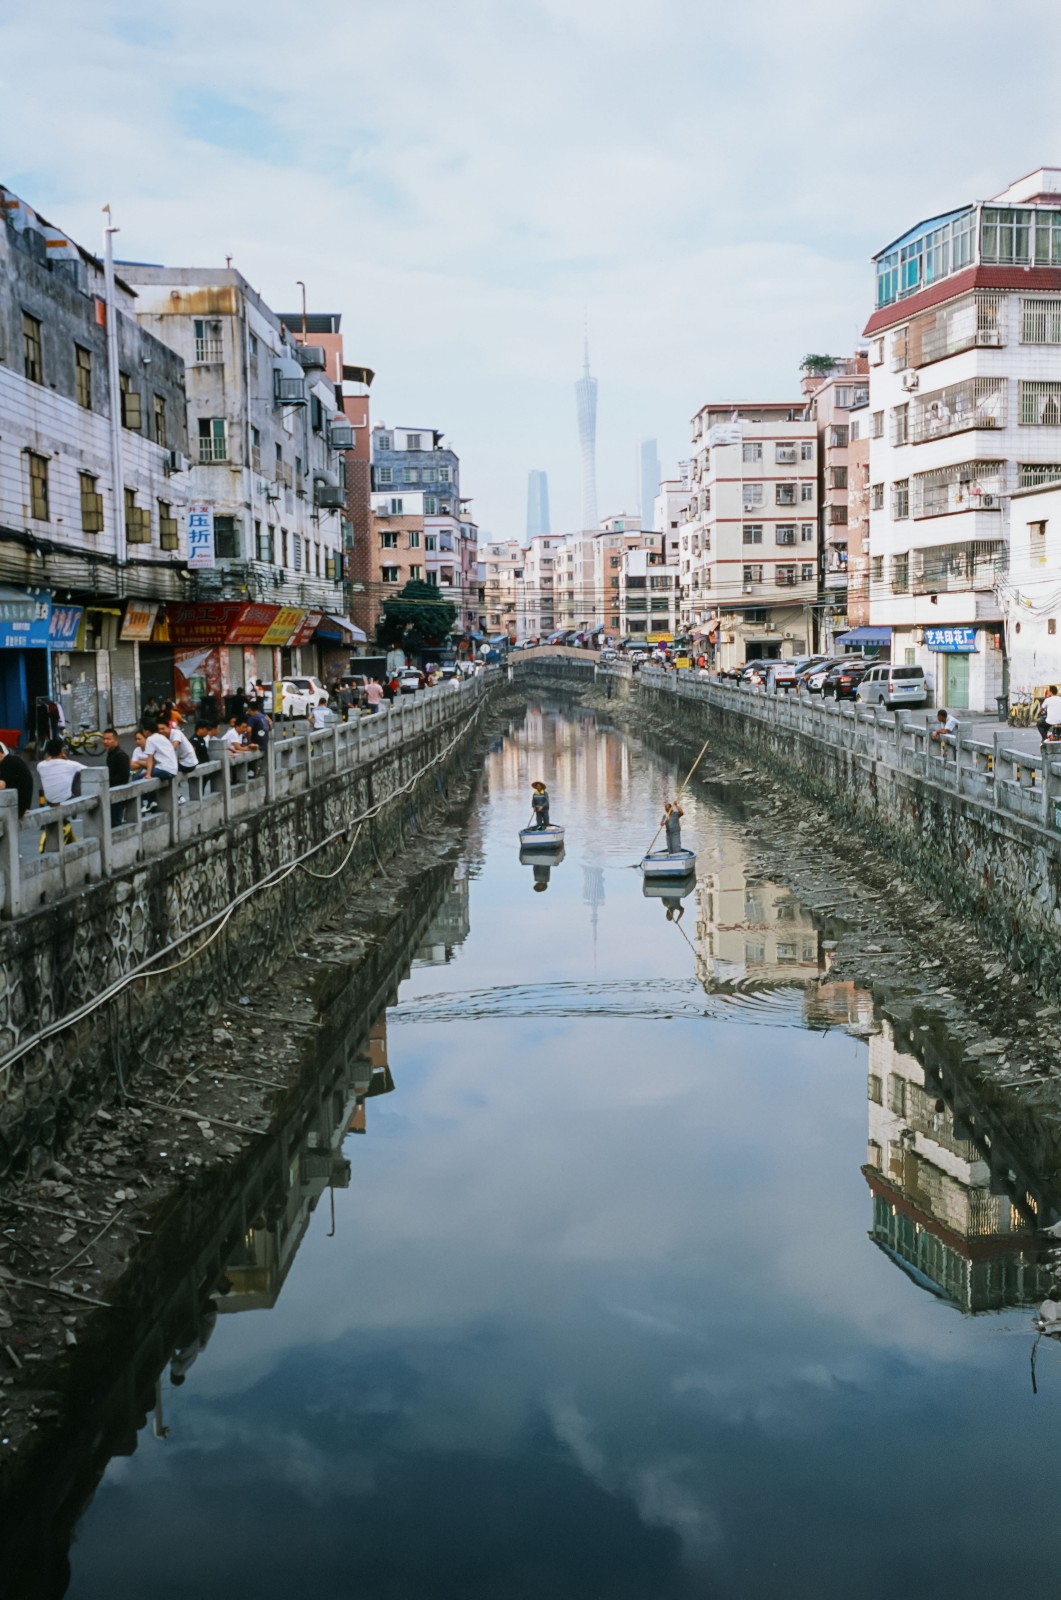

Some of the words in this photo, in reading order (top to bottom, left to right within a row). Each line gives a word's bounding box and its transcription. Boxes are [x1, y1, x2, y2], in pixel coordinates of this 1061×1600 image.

[188, 514, 211, 559] 压折厂
[925, 629, 972, 645] 艺兴印花厂
